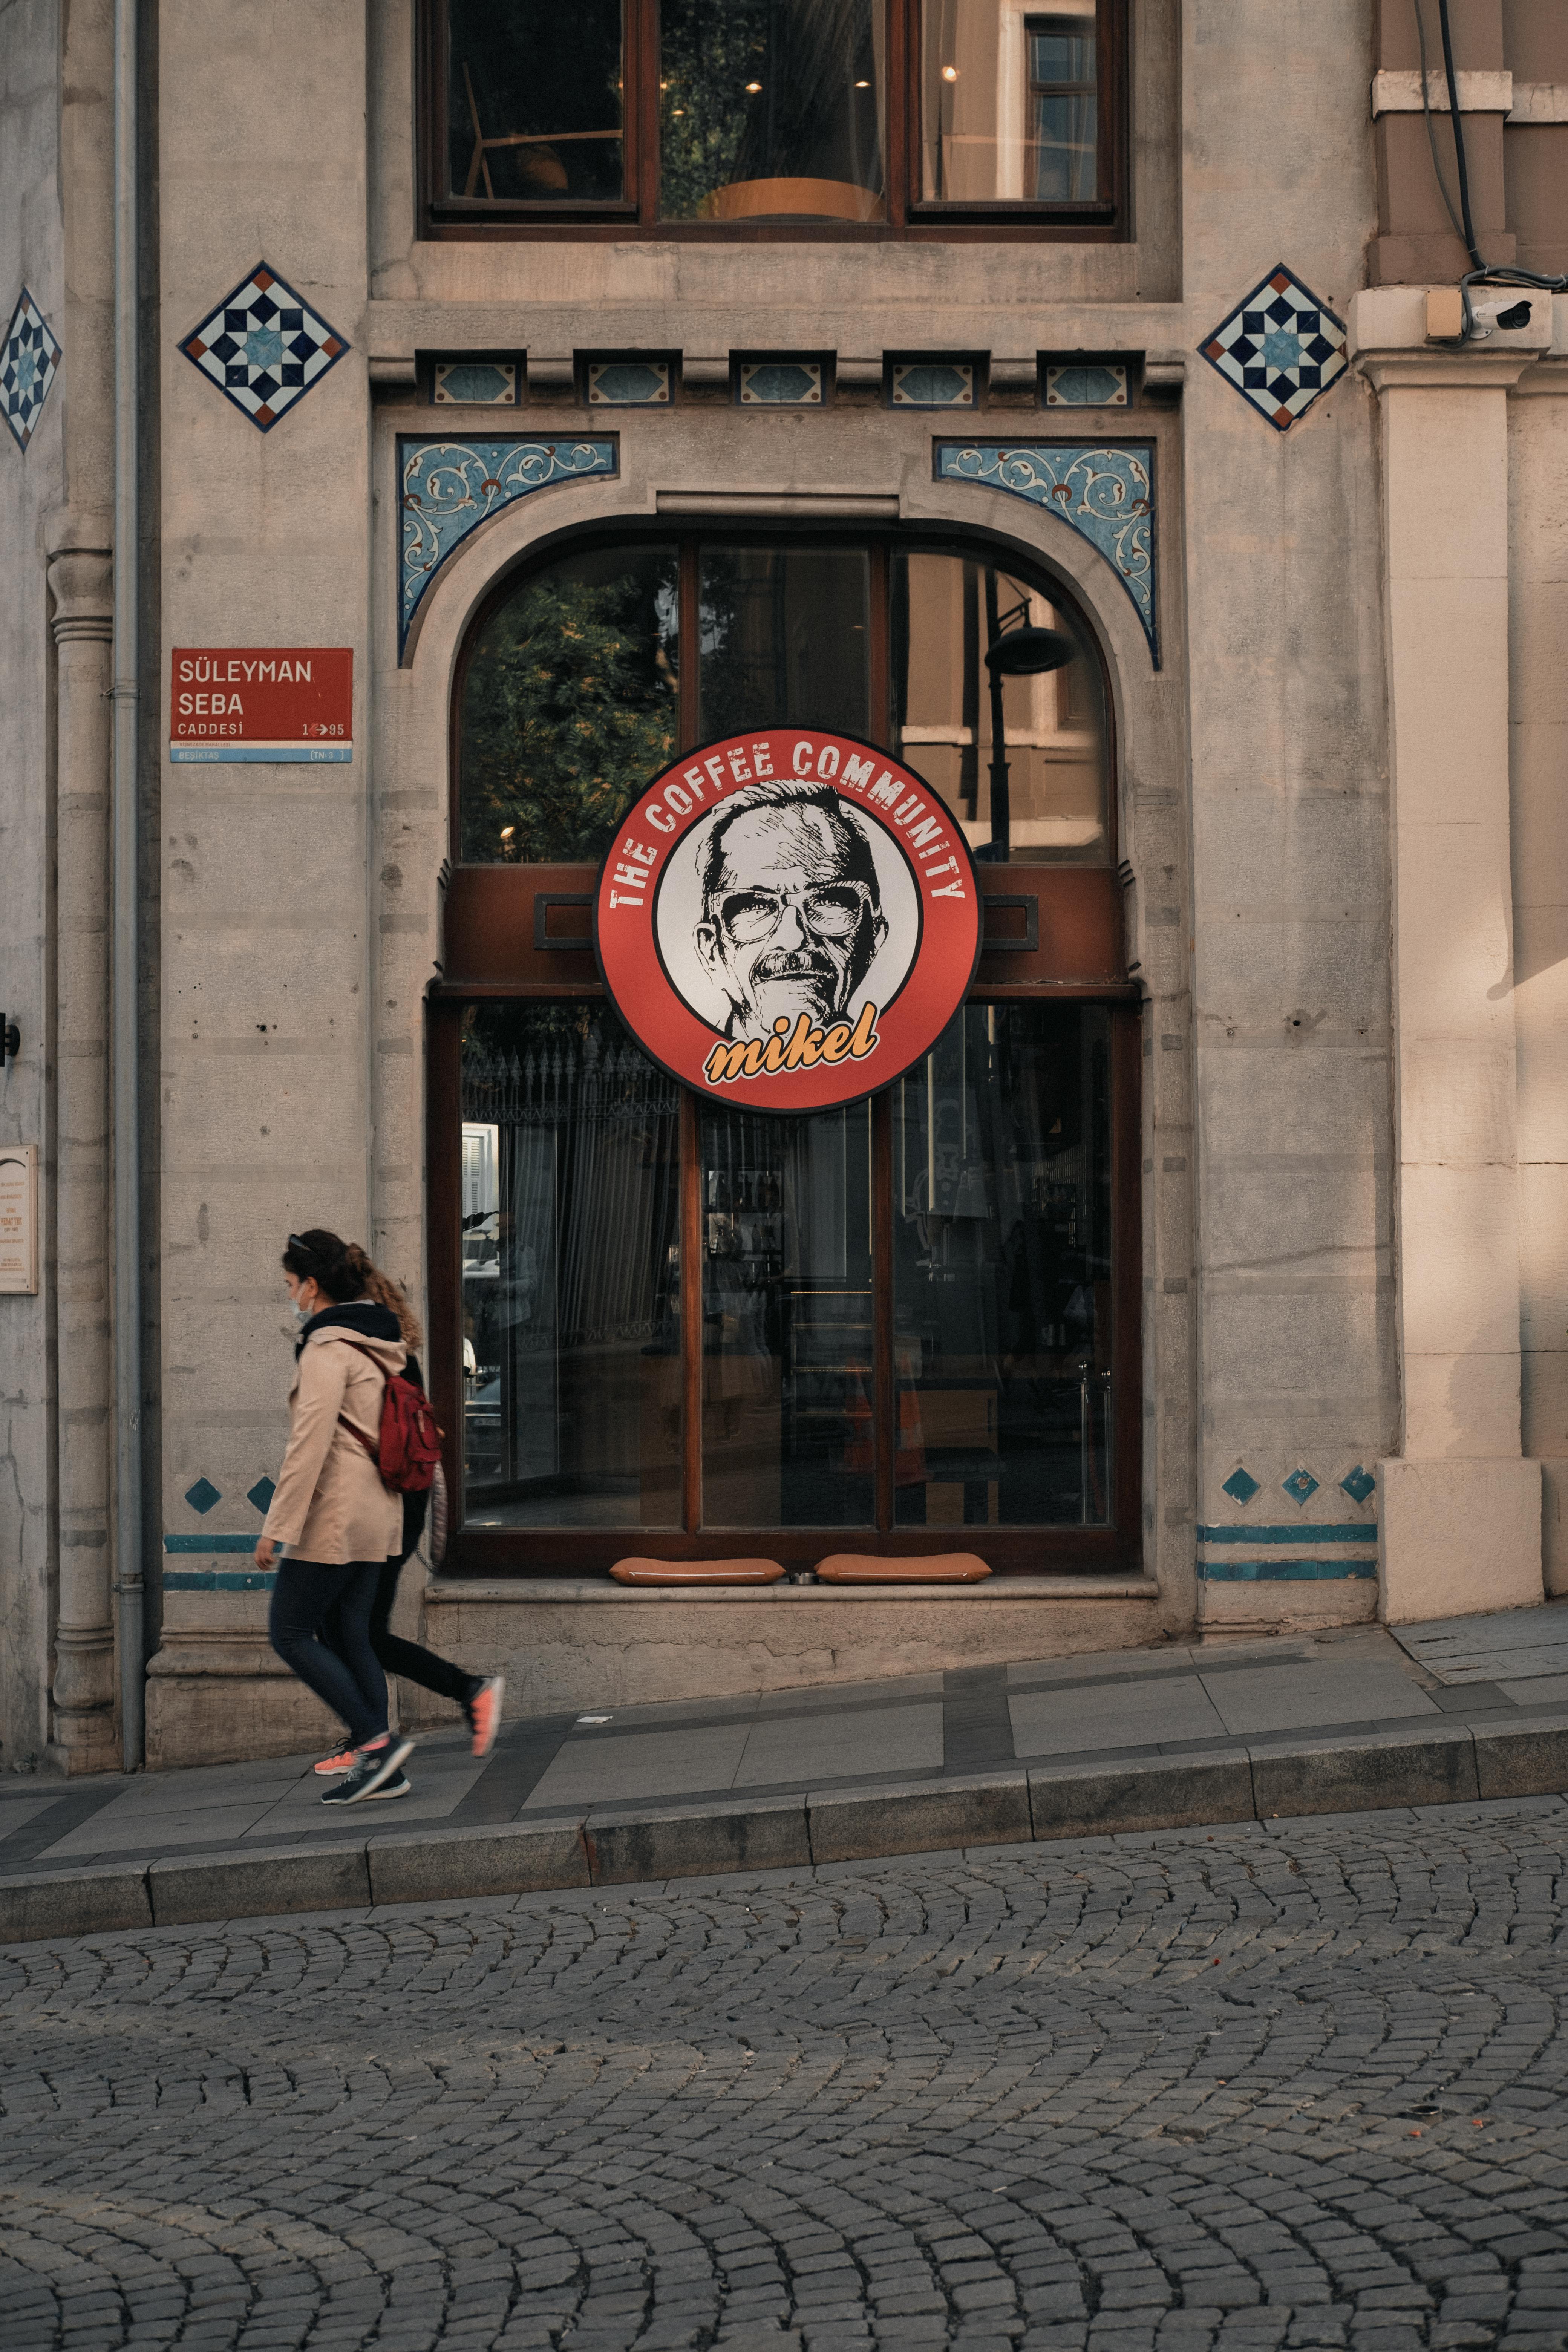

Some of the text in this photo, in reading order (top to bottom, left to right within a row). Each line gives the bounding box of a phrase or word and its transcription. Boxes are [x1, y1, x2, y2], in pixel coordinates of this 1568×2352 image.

[179, 656, 311, 682] SÜLEYMAN
[179, 693, 243, 715] SEBA
[178, 721, 242, 735] CADDESİ
[303, 724, 344, 735] 1 95
[179, 750, 219, 761] BEŞİKTAŞ
[609, 741, 966, 909] THE COFFEE COMMUNITY
[705, 1000, 877, 1083] mikel
